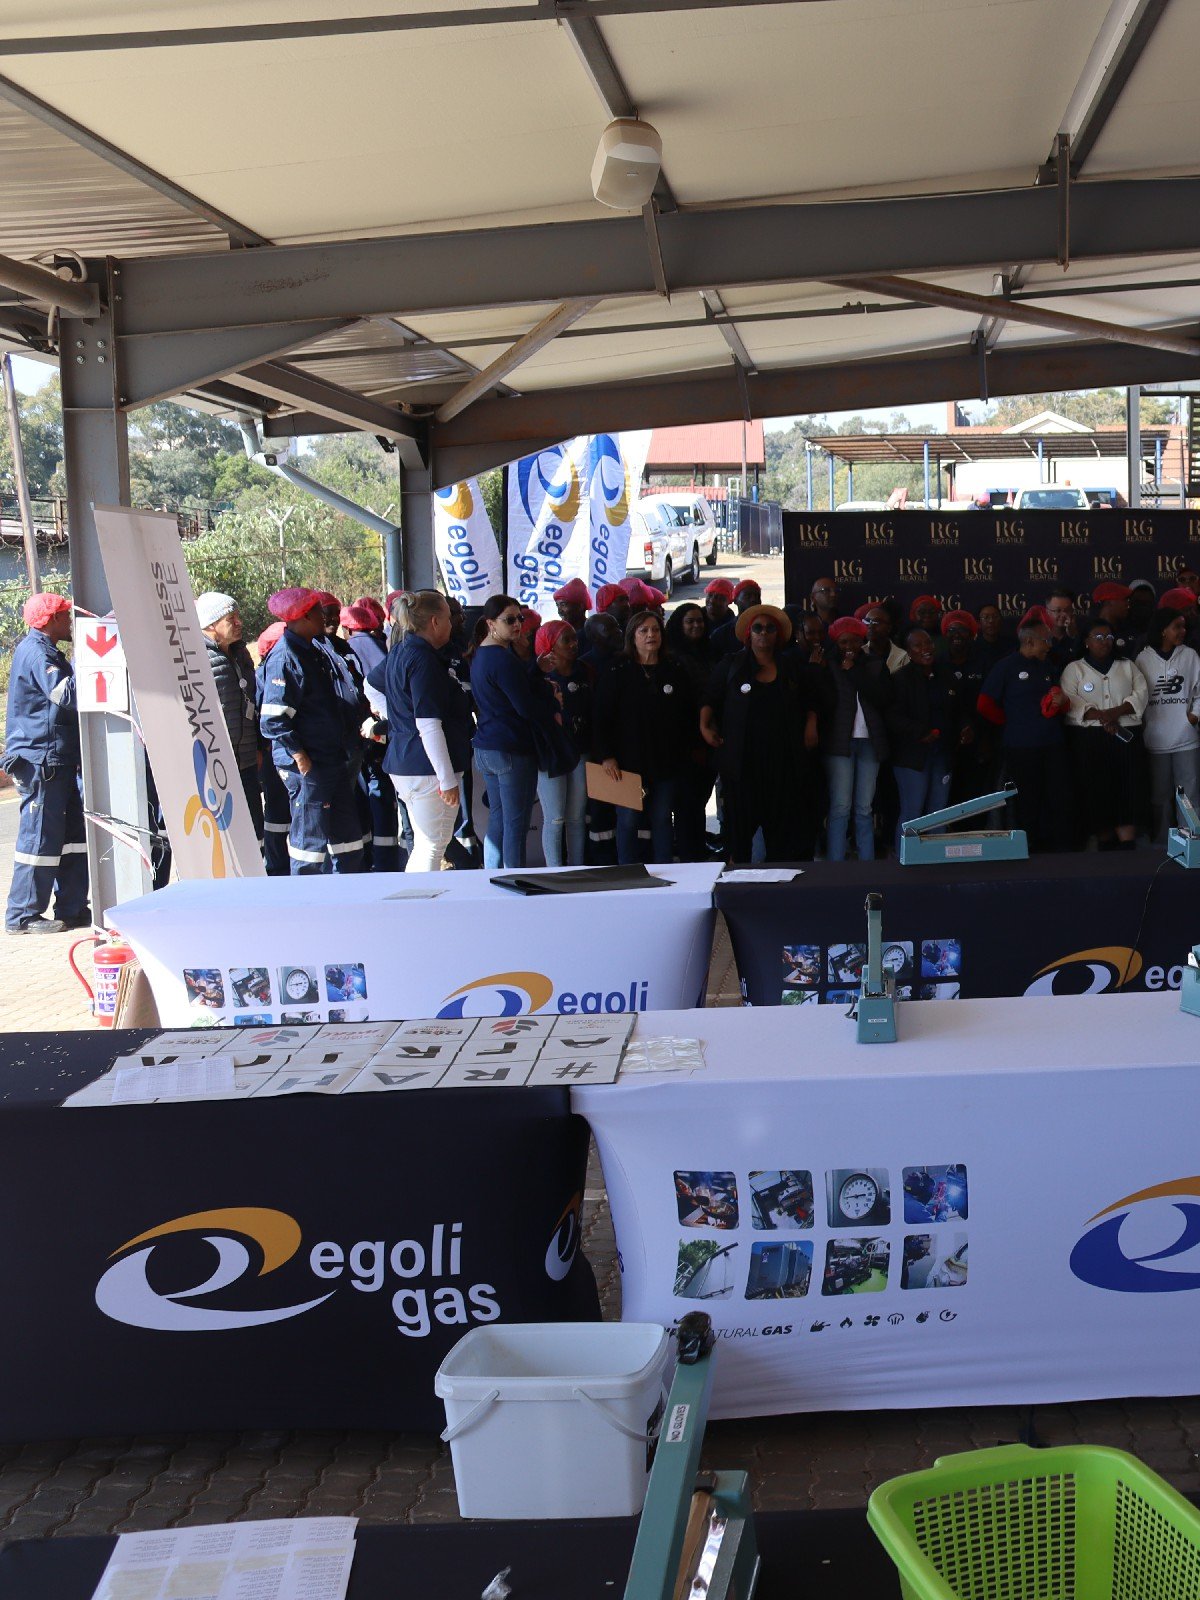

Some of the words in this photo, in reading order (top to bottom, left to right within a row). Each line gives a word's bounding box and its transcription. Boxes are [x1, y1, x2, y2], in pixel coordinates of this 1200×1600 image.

[800, 523, 830, 541] RG
[864, 522, 894, 540] RG
[930, 522, 959, 539] RG
[996, 520, 1024, 537] RG
[1060, 522, 1088, 537] RG
[1125, 520, 1153, 536] RG
[448, 525, 490, 591] egoli
[538, 524, 568, 593] egoli
[591, 524, 610, 590] egoli
[1029, 557, 1058, 574] RG
[1093, 556, 1122, 573] RG
[1157, 555, 1186, 572] RG
[834, 560, 863, 577] RG
[900, 558, 928, 576] RG
[964, 558, 992, 575] RG
[513, 553, 539, 604] gas
[998, 594, 1026, 610] RG
[151, 561, 199, 737] WELLNESS
[556, 981, 649, 1015] egoli
[309, 1221, 463, 1293] egoli
[391, 1283, 501, 1338] gas
[761, 1325, 792, 1336] GAS
